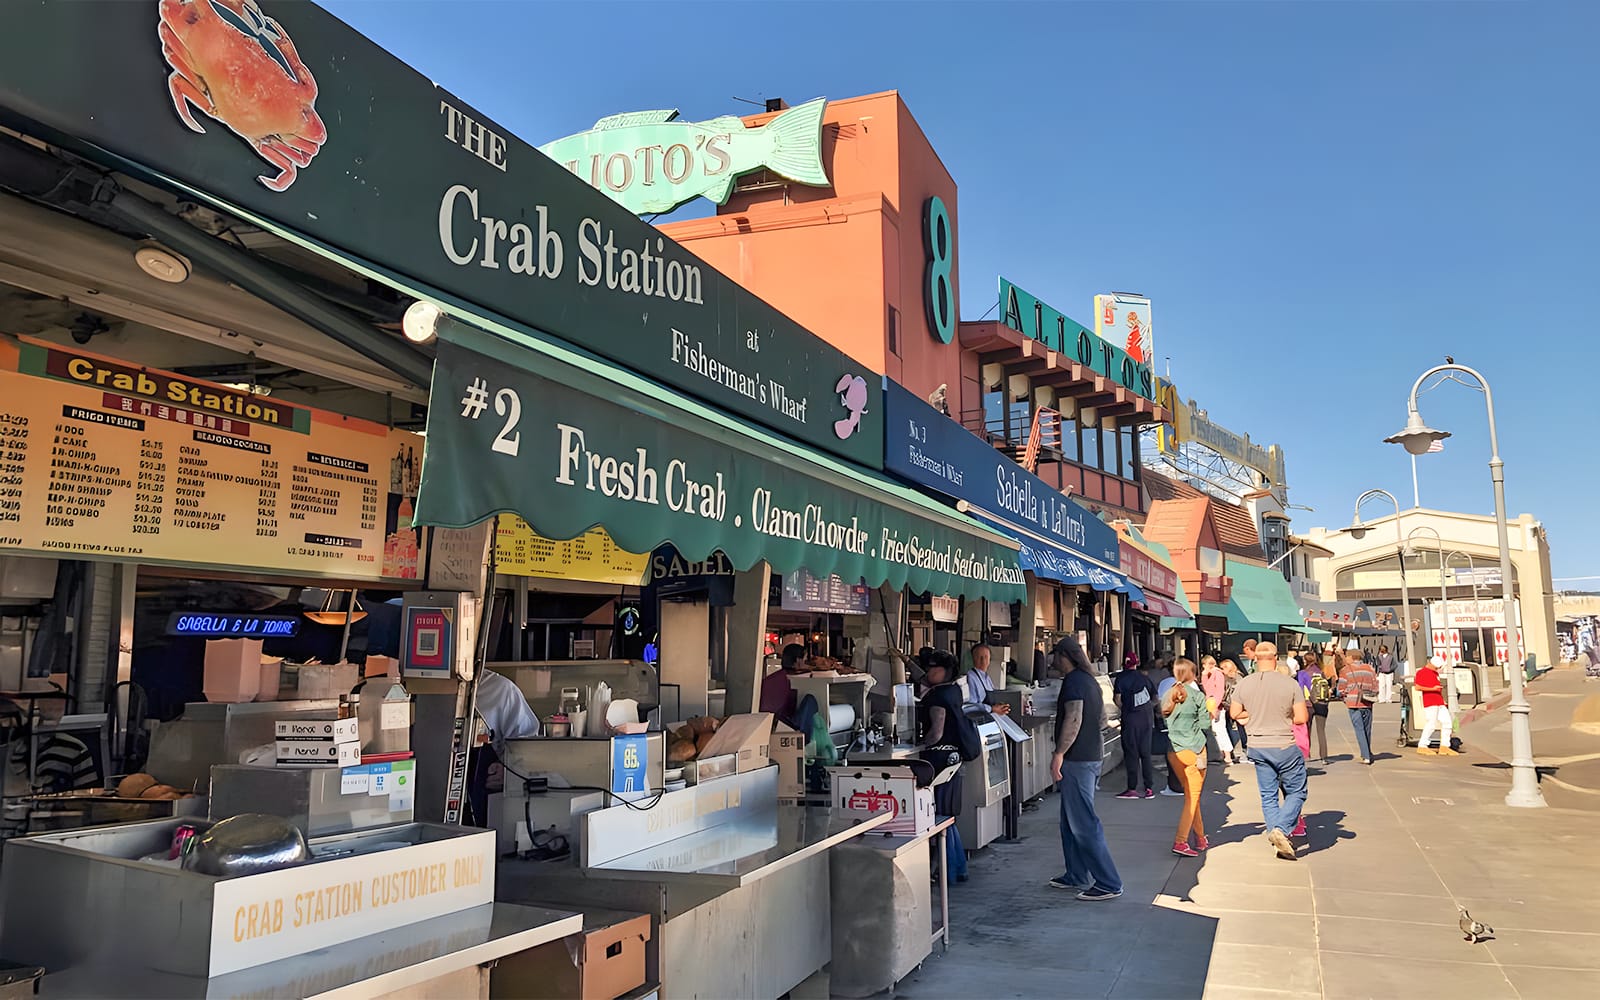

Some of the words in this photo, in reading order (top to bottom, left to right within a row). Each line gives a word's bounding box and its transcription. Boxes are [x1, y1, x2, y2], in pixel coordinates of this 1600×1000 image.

[440, 101, 507, 172] THE
[438, 184, 563, 279] Crab
[578, 217, 703, 305] Station
[923, 195, 955, 344] 8
[671, 327, 766, 405] Fisherman's
[769, 380, 807, 424] Wharf
[746, 329, 759, 353] at
[1005, 284, 1152, 400] ALIOTO'S
[67, 357, 157, 396] Crab
[166, 381, 279, 424] Station
[556, 423, 658, 505] Fresh
[664, 460, 727, 523] Crab
[752, 487, 802, 540] Clam
[997, 464, 1039, 523] Sabella
[232, 898, 284, 943] CRAB
[293, 880, 363, 928] STATION
[371, 863, 446, 908] CUSTOMER
[454, 855, 485, 888] ONLY
